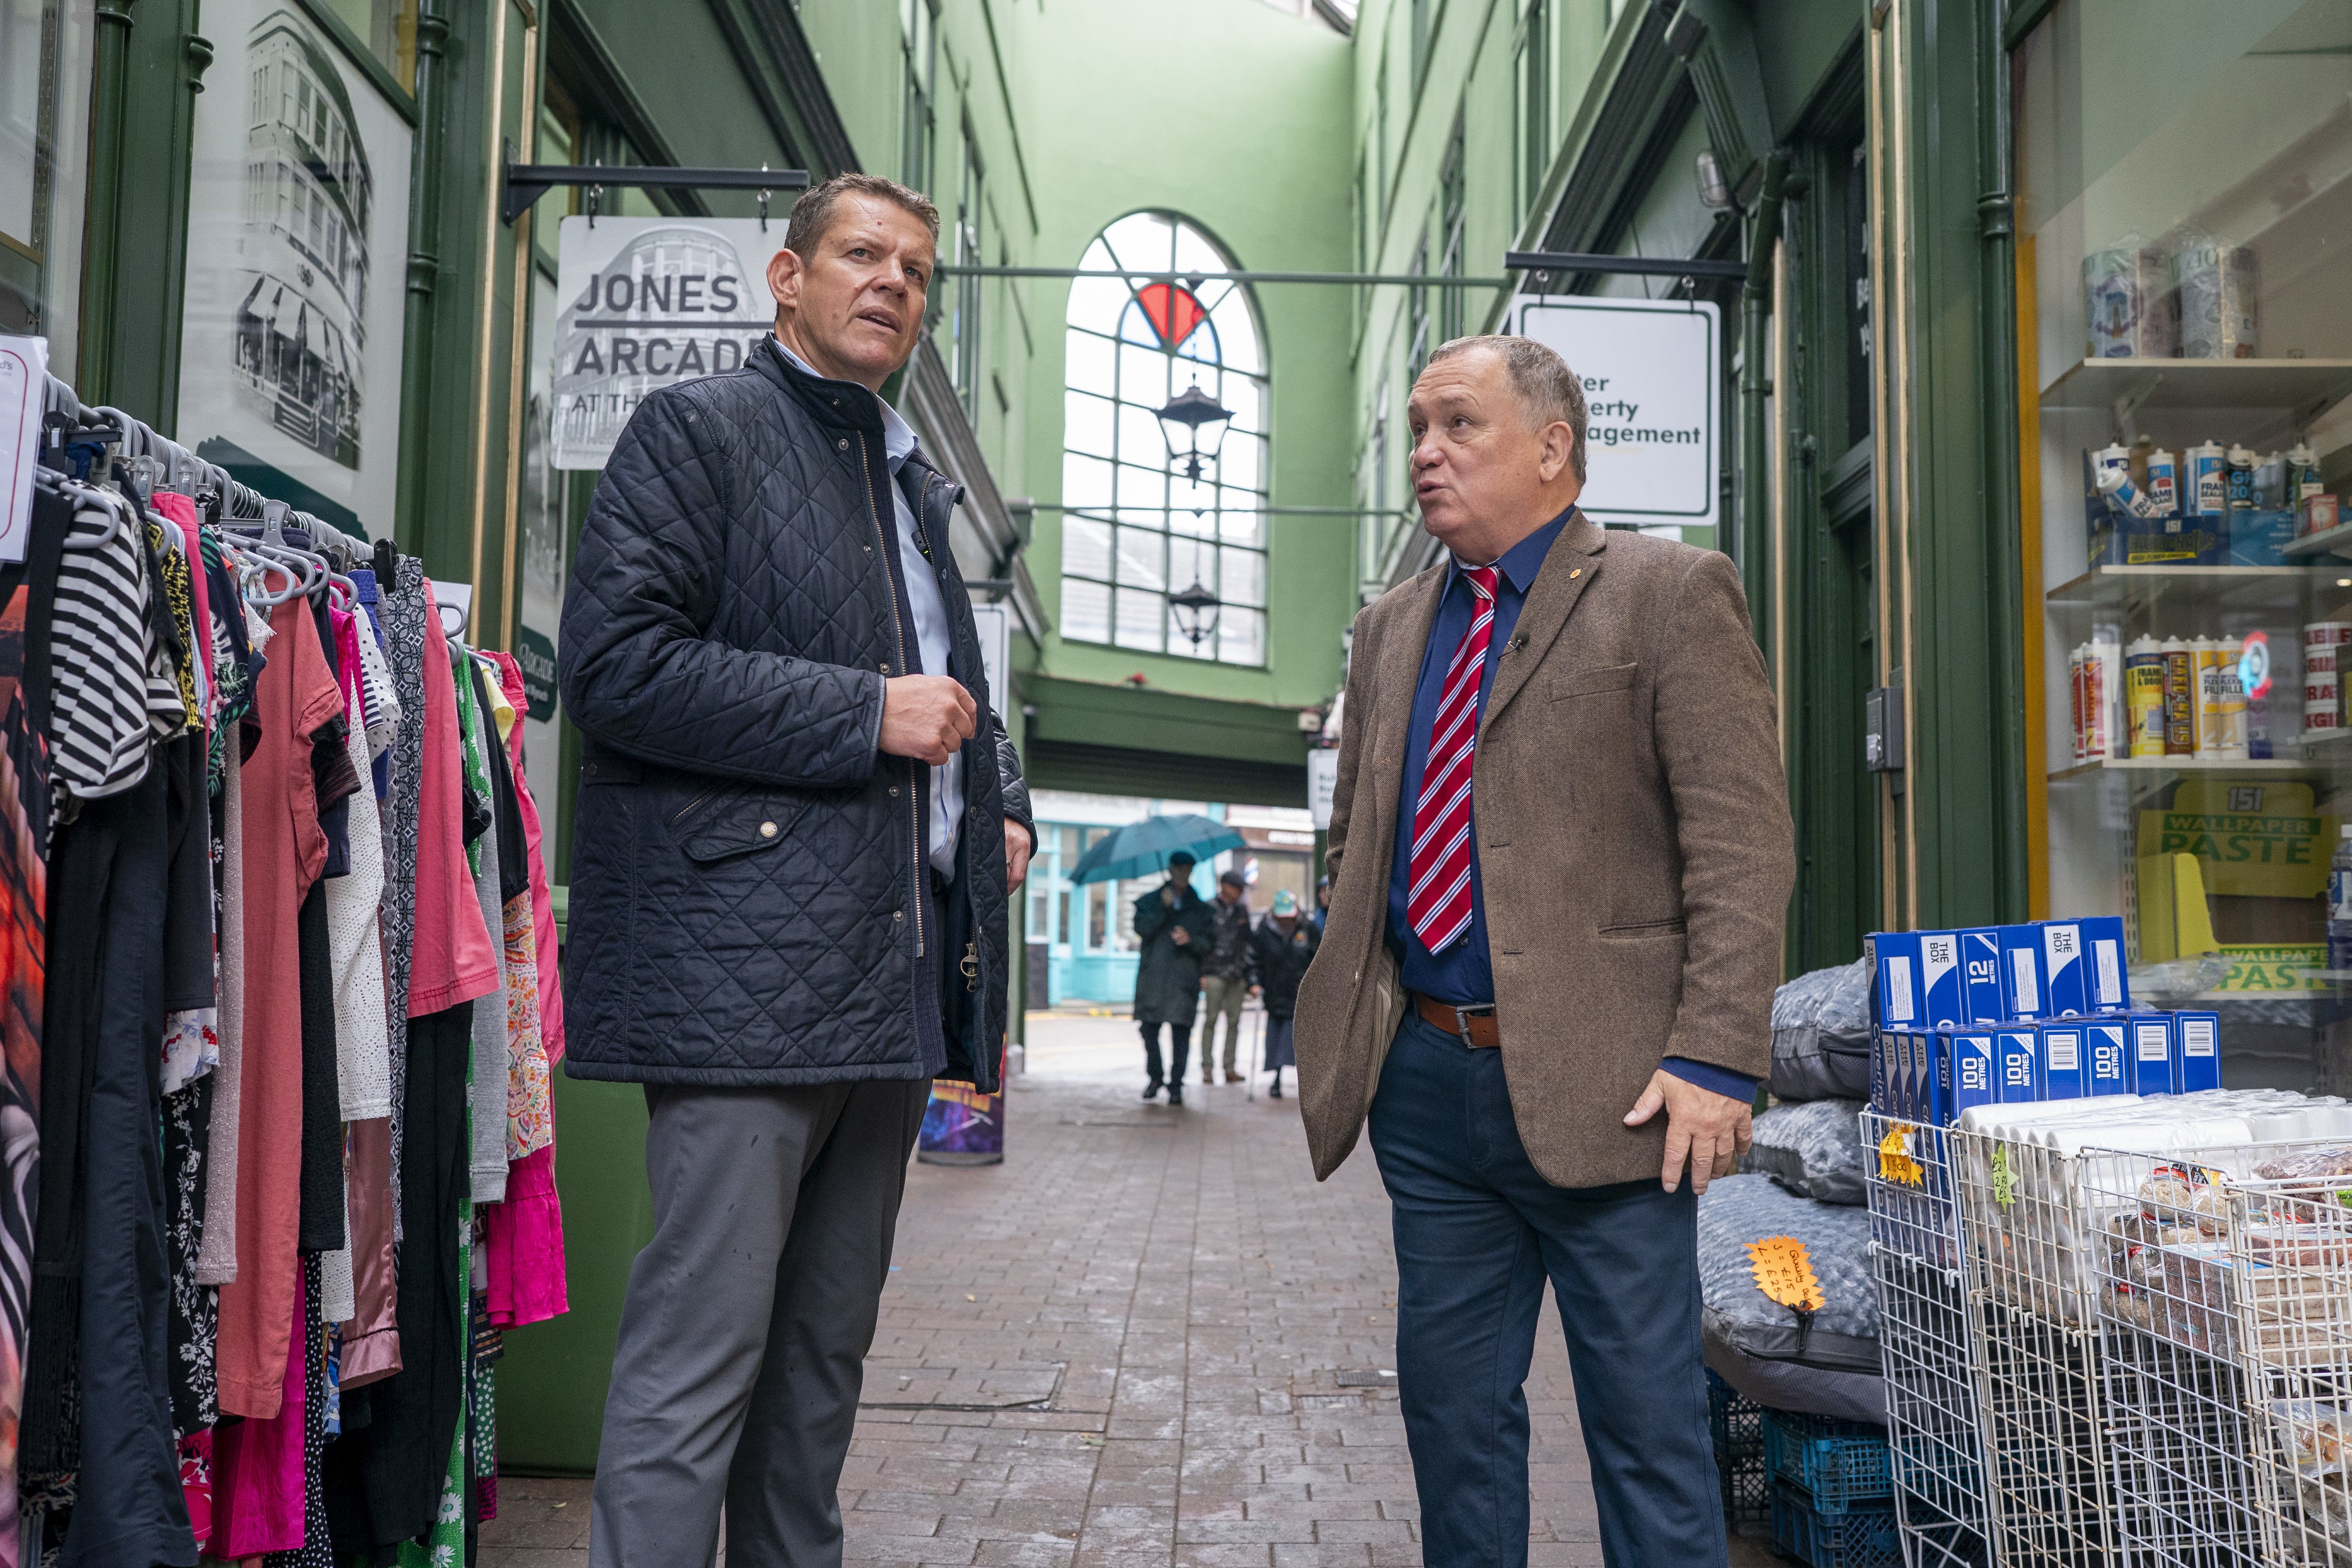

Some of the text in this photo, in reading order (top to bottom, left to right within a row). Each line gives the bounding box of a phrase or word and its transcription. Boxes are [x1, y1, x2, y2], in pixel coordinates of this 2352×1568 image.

[575, 274, 738, 313] JONES
[0, 360, 13, 370] d's
[1576, 374, 1610, 391] ter
[572, 394, 601, 412] AT
[608, 394, 644, 412] TH
[1590, 399, 1638, 422] erty
[1587, 426, 1701, 446] agement
[2171, 817, 2310, 834] WALLPAPER
[2161, 833, 2312, 864] PASTE
[1930, 942, 1939, 963] BOX
[1939, 942, 1949, 963] THE
[2053, 933, 2063, 953] BOX
[2063, 932, 2072, 953] THE
[1968, 960, 1989, 985] 12
[1974, 1040, 1990, 1055] CATERING
[1873, 1023, 1885, 1111] Catering
[1962, 1057, 1978, 1089] 100
[1978, 1057, 1986, 1090] METRES
[2006, 1054, 2022, 1086] 100
[2022, 1053, 2030, 1086] METRES
[2095, 1046, 2112, 1079] 100
[2111, 1046, 2120, 1079] METRES
[1995, 1176, 2000, 1187] 2
[1758, 1247, 1768, 1256] L
[1766, 1270, 1783, 1293] £25
[1789, 1250, 1804, 1283] Quality
[1781, 1267, 1795, 1291] £15
